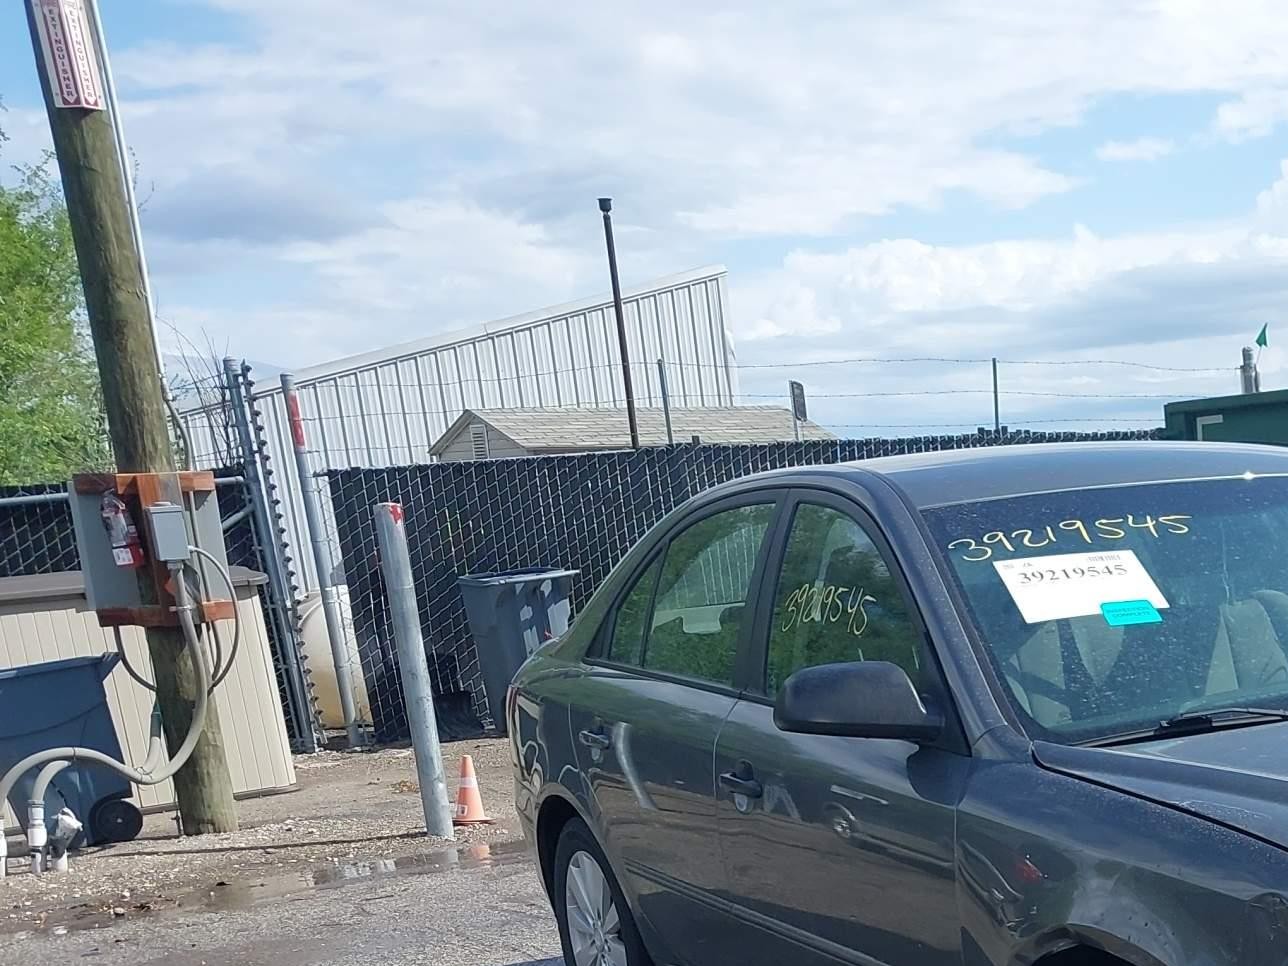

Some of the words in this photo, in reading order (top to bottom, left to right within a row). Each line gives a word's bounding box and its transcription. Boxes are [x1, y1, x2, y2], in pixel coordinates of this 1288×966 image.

[47, 8, 75, 97] EXTINGUISHER
[947, 513, 1193, 562] 39219545
[1017, 563, 1128, 585] 39219545
[781, 582, 878, 636] 39219545
